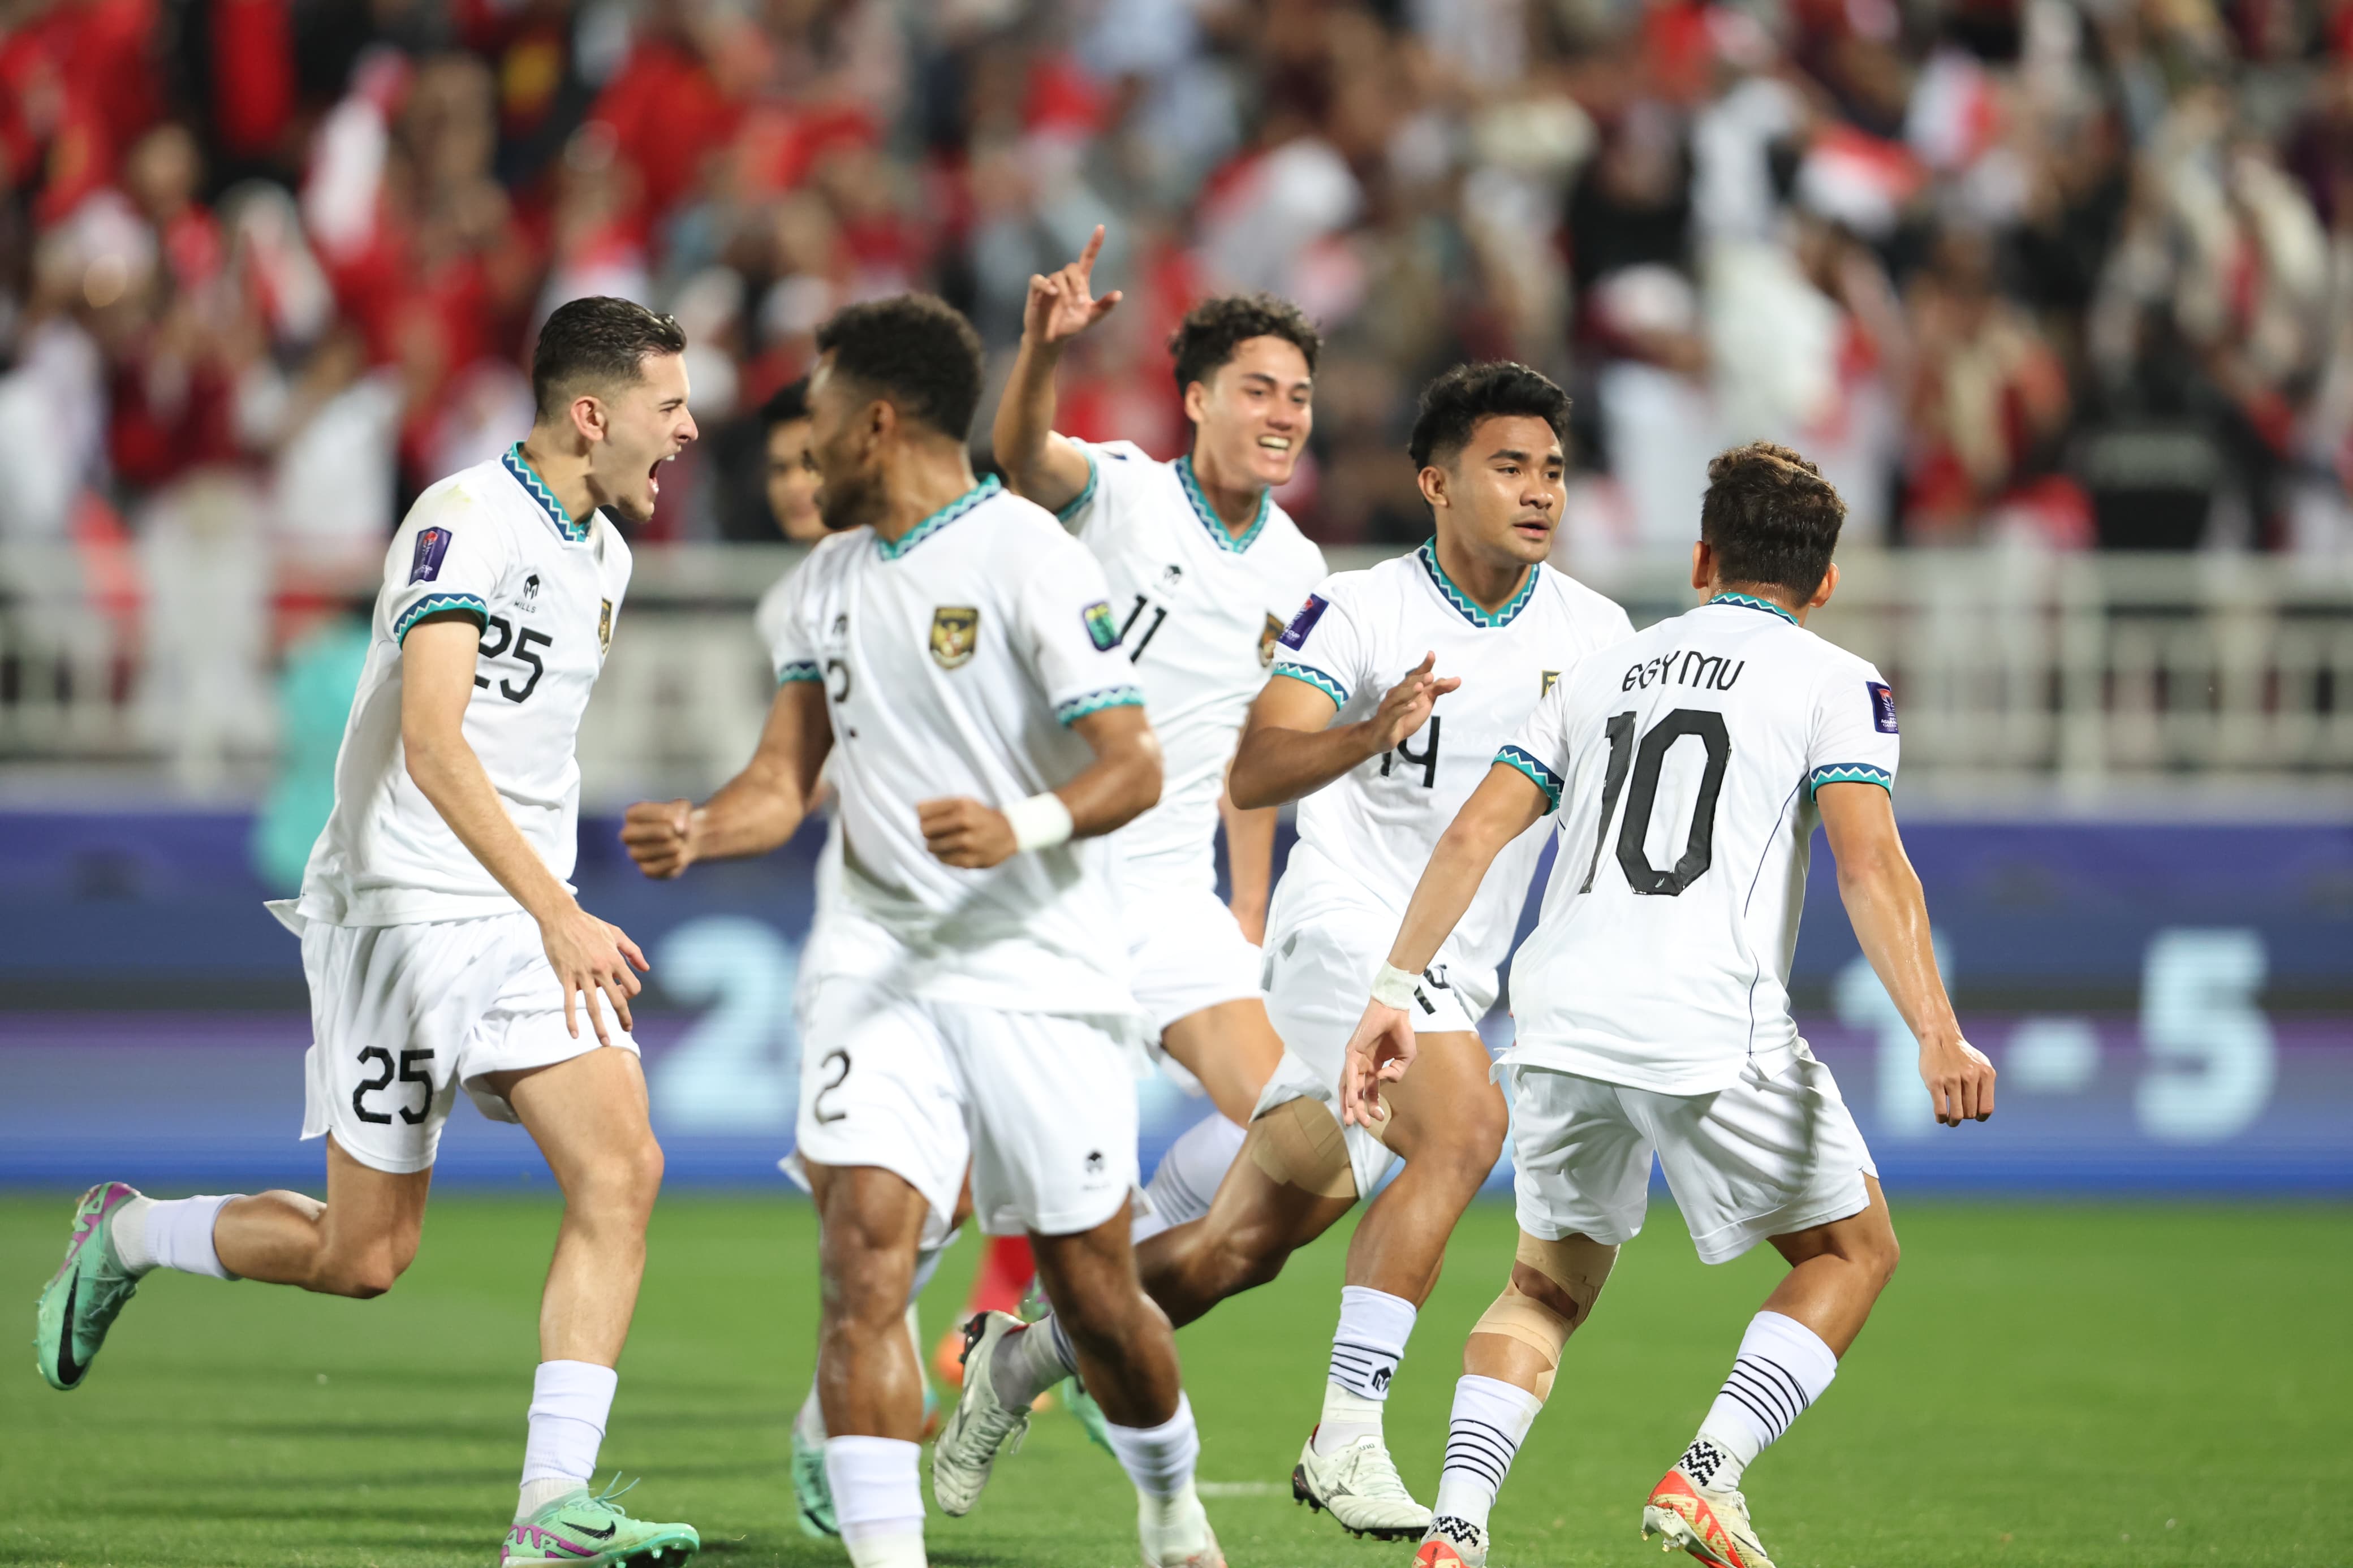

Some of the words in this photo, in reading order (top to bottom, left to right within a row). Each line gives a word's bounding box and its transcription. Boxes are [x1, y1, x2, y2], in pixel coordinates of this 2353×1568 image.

[514, 600, 536, 614] MILLS
[474, 615, 553, 703] 25
[1622, 650, 1681, 692] EGY
[1578, 708, 1732, 897] 10
[353, 1045, 434, 1125] 25
[815, 1047, 851, 1125] 2
